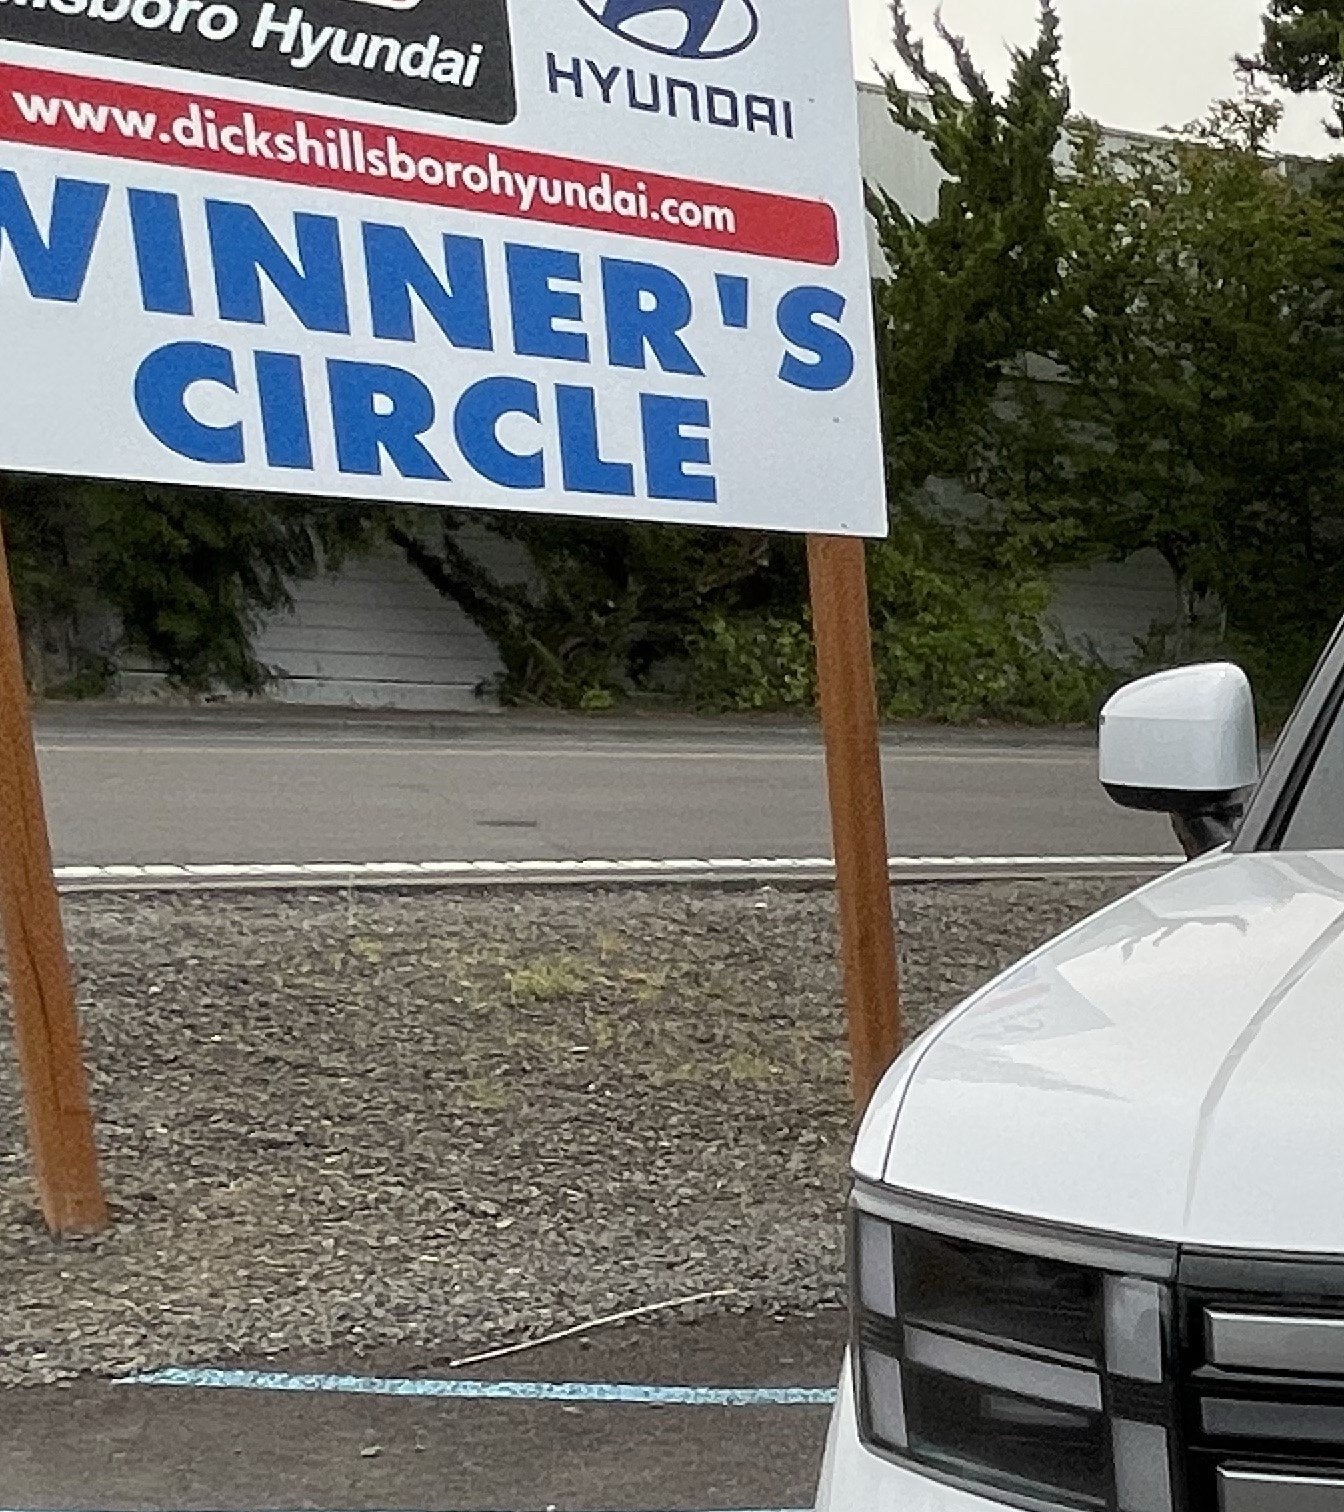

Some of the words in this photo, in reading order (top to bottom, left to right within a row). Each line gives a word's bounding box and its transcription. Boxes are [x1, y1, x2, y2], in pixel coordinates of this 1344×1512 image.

[252, 7, 485, 89] Hyundai
[545, 52, 795, 140] HYUNDAI
[12, 89, 737, 235] www.dickshillsborohyundai.com
[133, 341, 718, 503] CIRCLE
